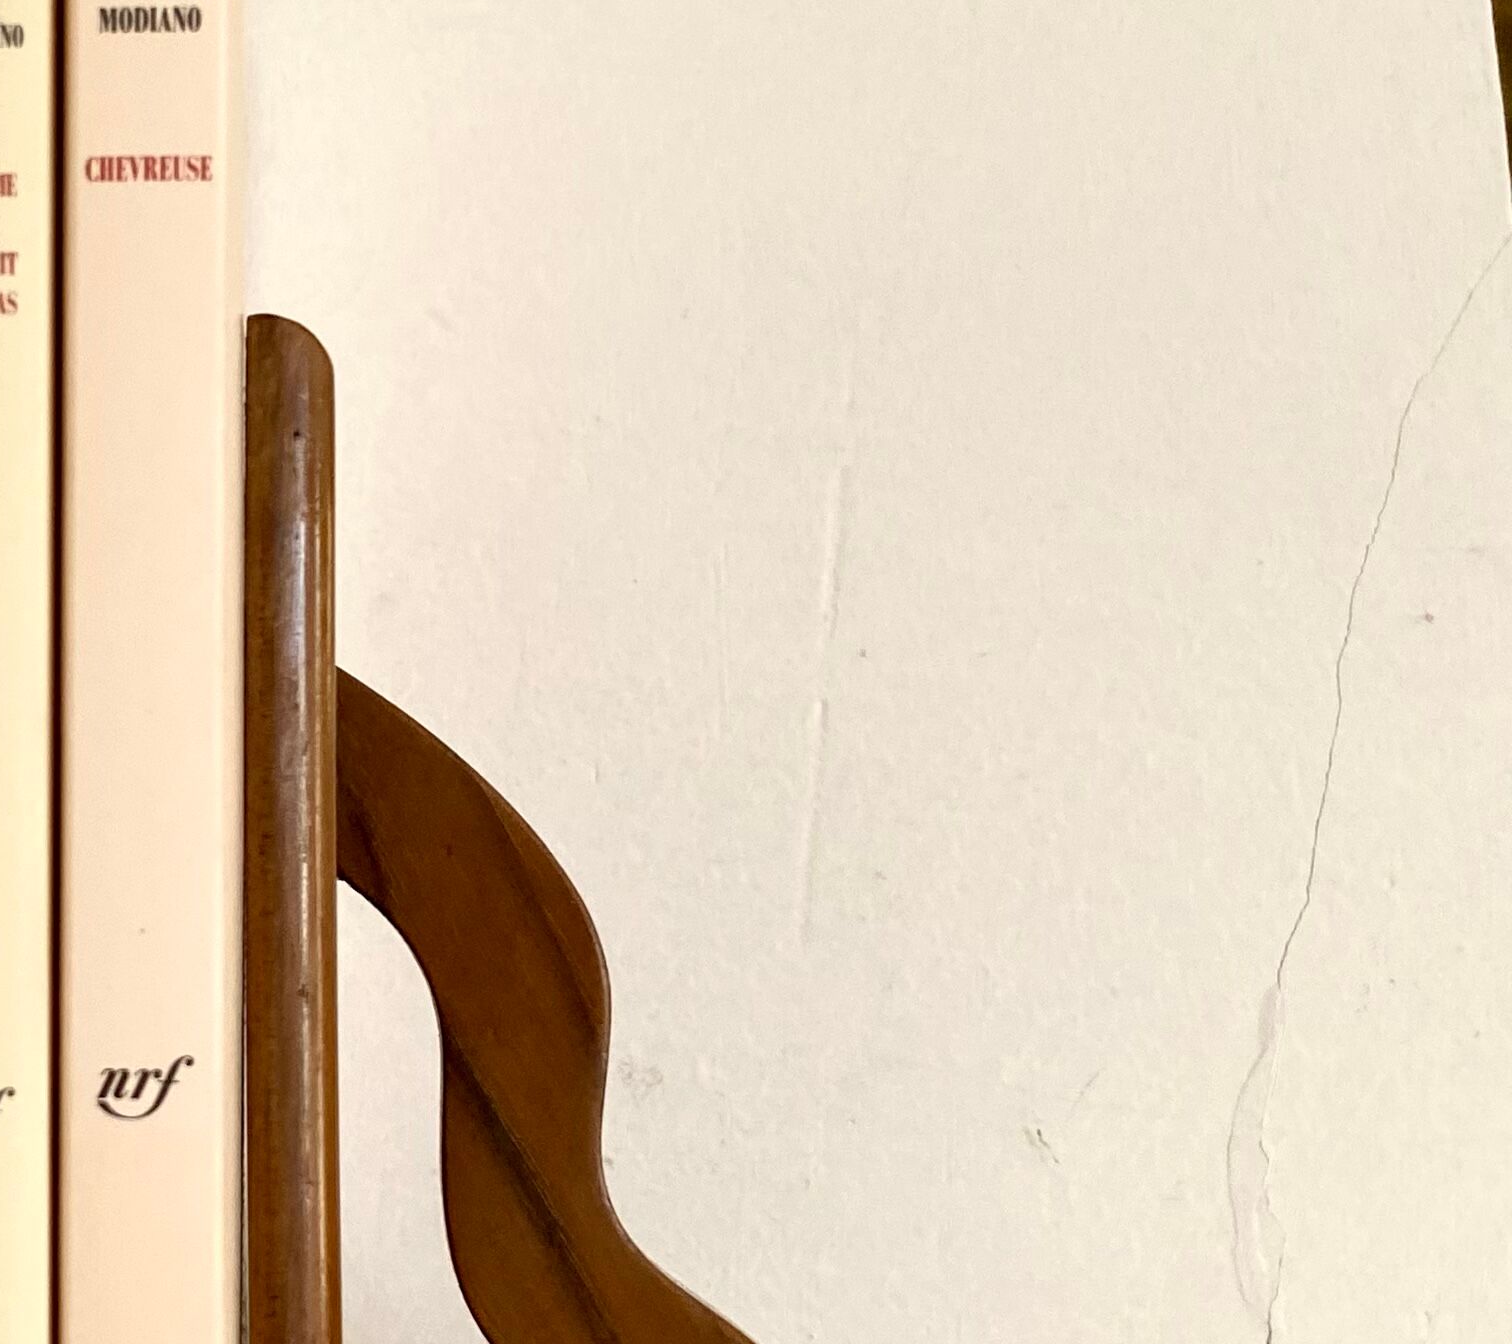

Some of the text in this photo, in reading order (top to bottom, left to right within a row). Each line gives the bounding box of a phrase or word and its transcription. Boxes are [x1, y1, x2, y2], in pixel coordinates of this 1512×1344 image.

[99, 6, 202, 33] MODIANO
[84, 155, 212, 182] CHEVREUSE
[97, 1055, 194, 1119] nrf
